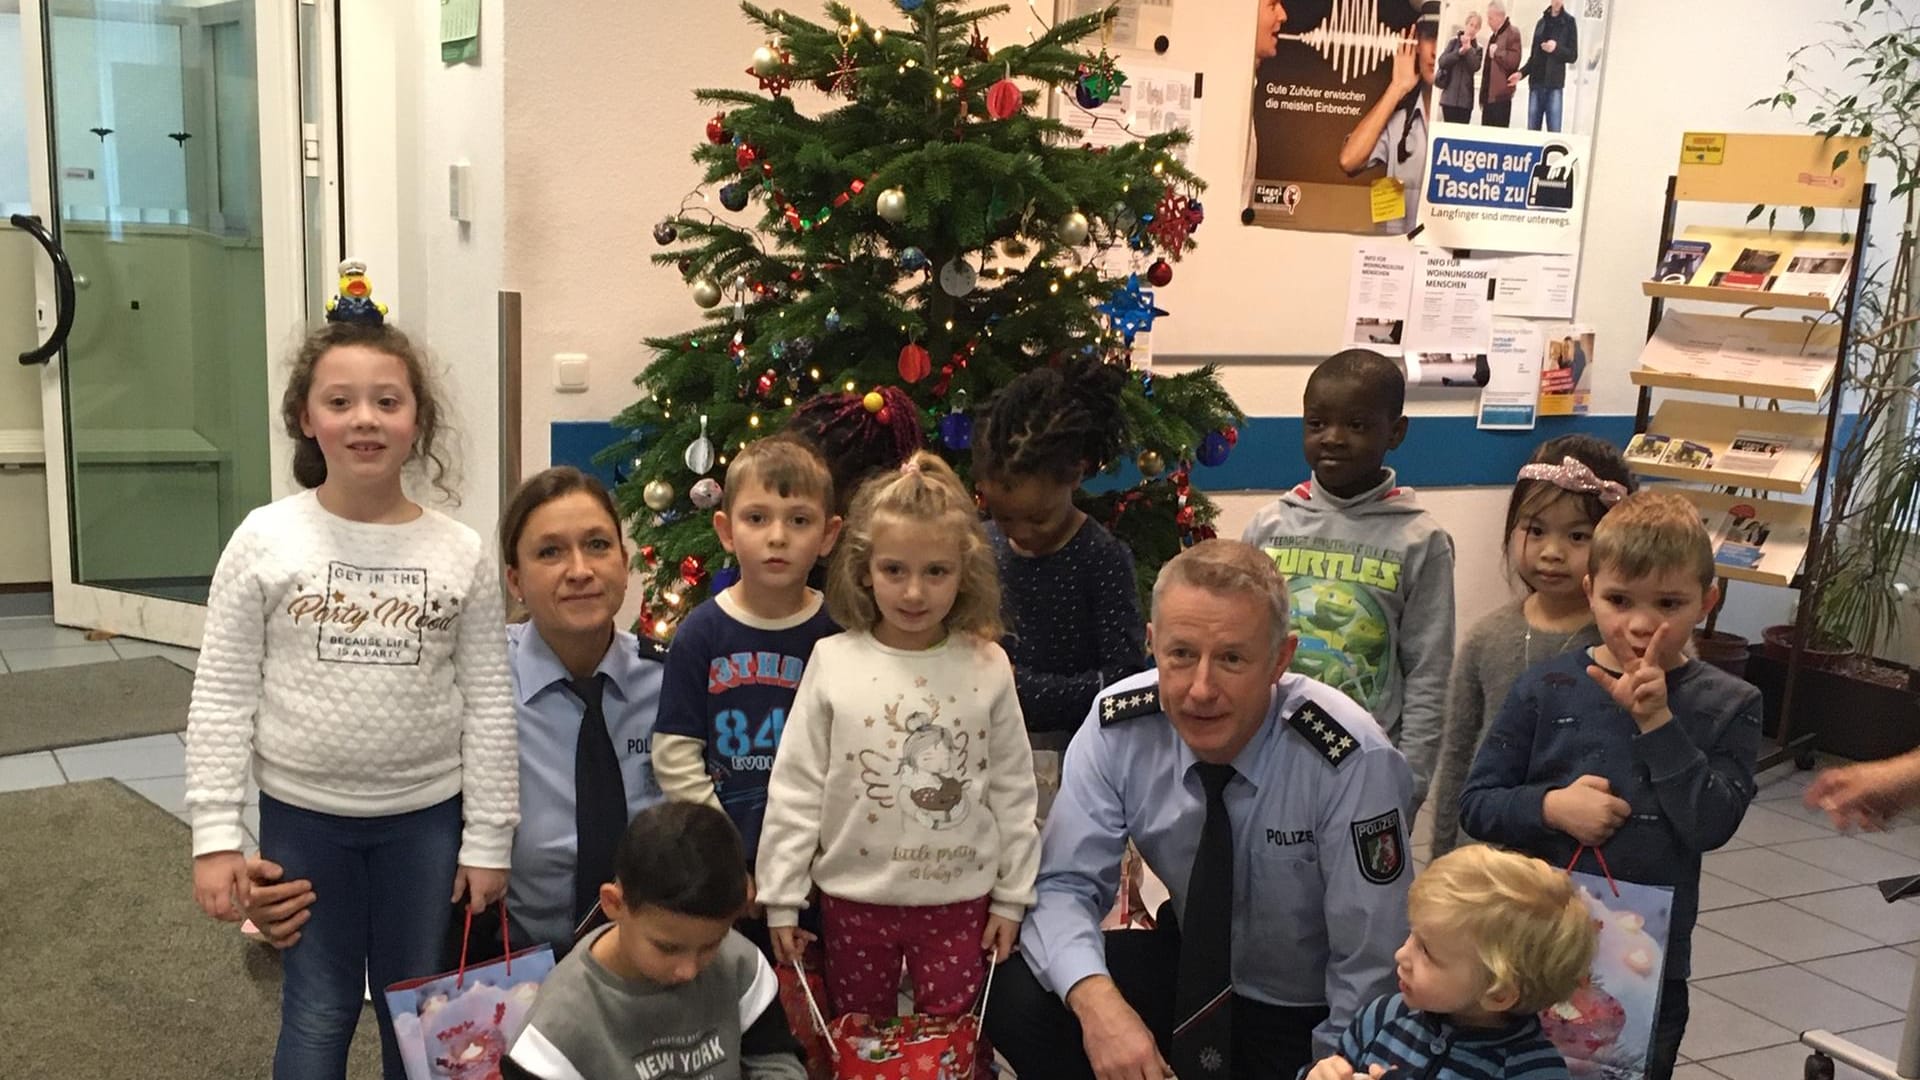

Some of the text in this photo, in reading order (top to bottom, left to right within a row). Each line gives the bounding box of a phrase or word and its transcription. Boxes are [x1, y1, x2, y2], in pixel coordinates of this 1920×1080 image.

[1266, 82, 1366, 102] Gute Zuhörer erwischen
[1265, 98, 1362, 116] die meisten Einbrecher.
[1436, 142, 1532, 173] Augen auf
[1486, 172, 1505, 184] und
[1435, 173, 1500, 202] Tasche
[1504, 185, 1525, 203] zu
[1431, 207, 1479, 221] Langfinger
[1481, 210, 1499, 221] sind
[1500, 212, 1526, 223] immer
[1427, 258, 1446, 267] INFO
[1426, 269, 1489, 280] WOHNUNGSLOSE
[1425, 279, 1467, 289] MENSCHEN
[334, 567, 420, 585] GET IN THE
[287, 593, 459, 634] Party Mood
[329, 635, 410, 649] BECAUSE LIFE
[352, 648, 360, 657] A
[364, 648, 401, 658] PARTY
[715, 707, 785, 758] 84
[634, 1051, 675, 1080] NEW
[679, 1035, 725, 1073] YORK
